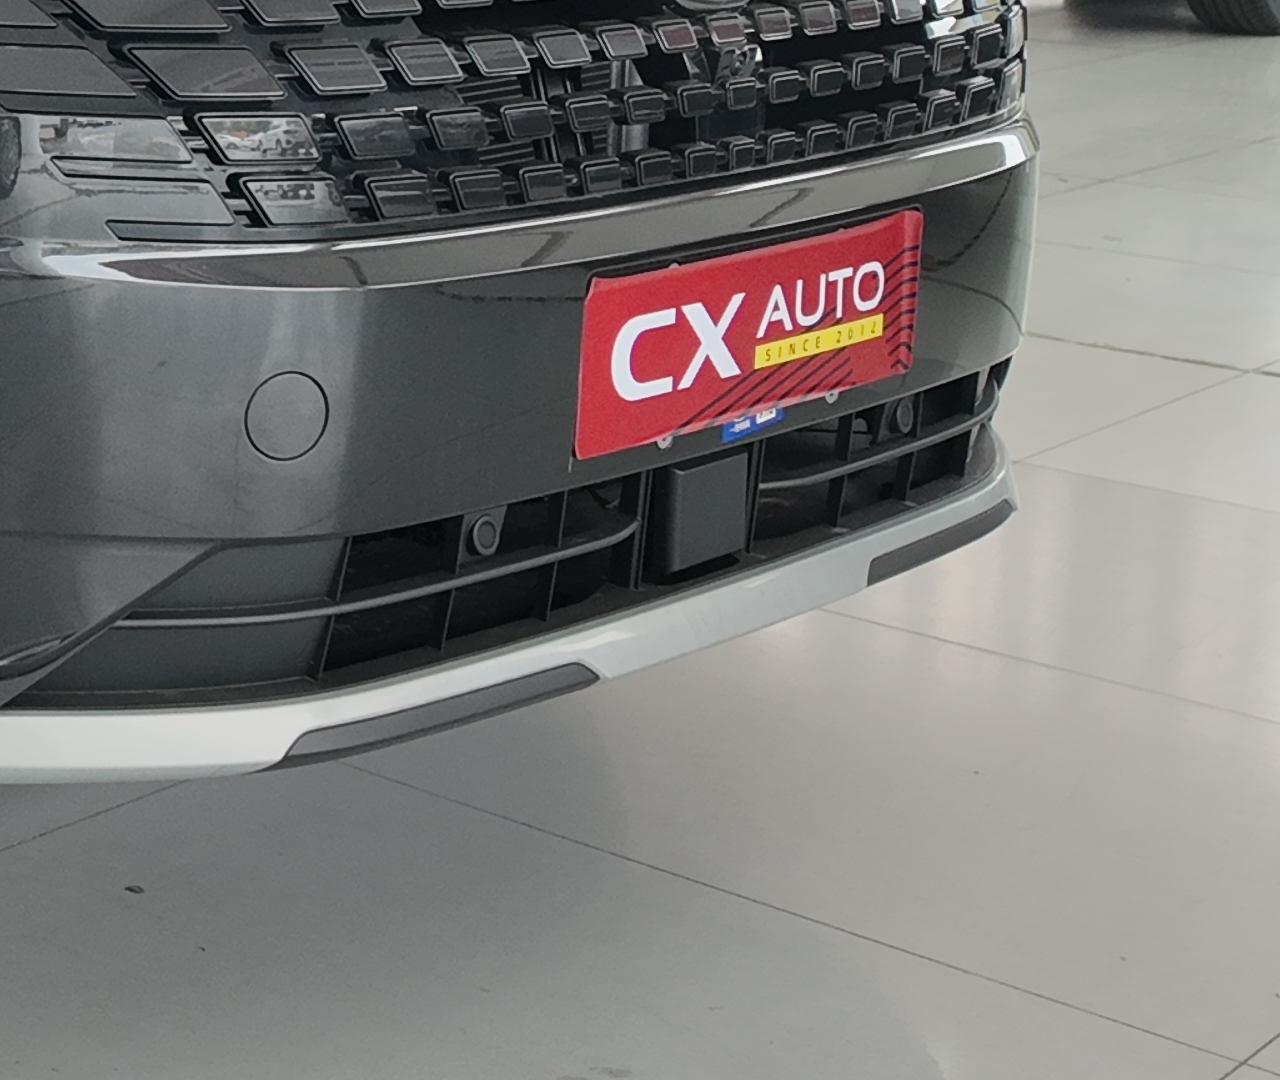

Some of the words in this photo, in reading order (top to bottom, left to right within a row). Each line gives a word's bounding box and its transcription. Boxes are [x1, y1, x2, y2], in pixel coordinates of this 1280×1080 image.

[755, 260, 885, 339] AUTO
[610, 291, 746, 402] CX
[765, 336, 822, 362] SINCE
[835, 320, 878, 345] 2012
